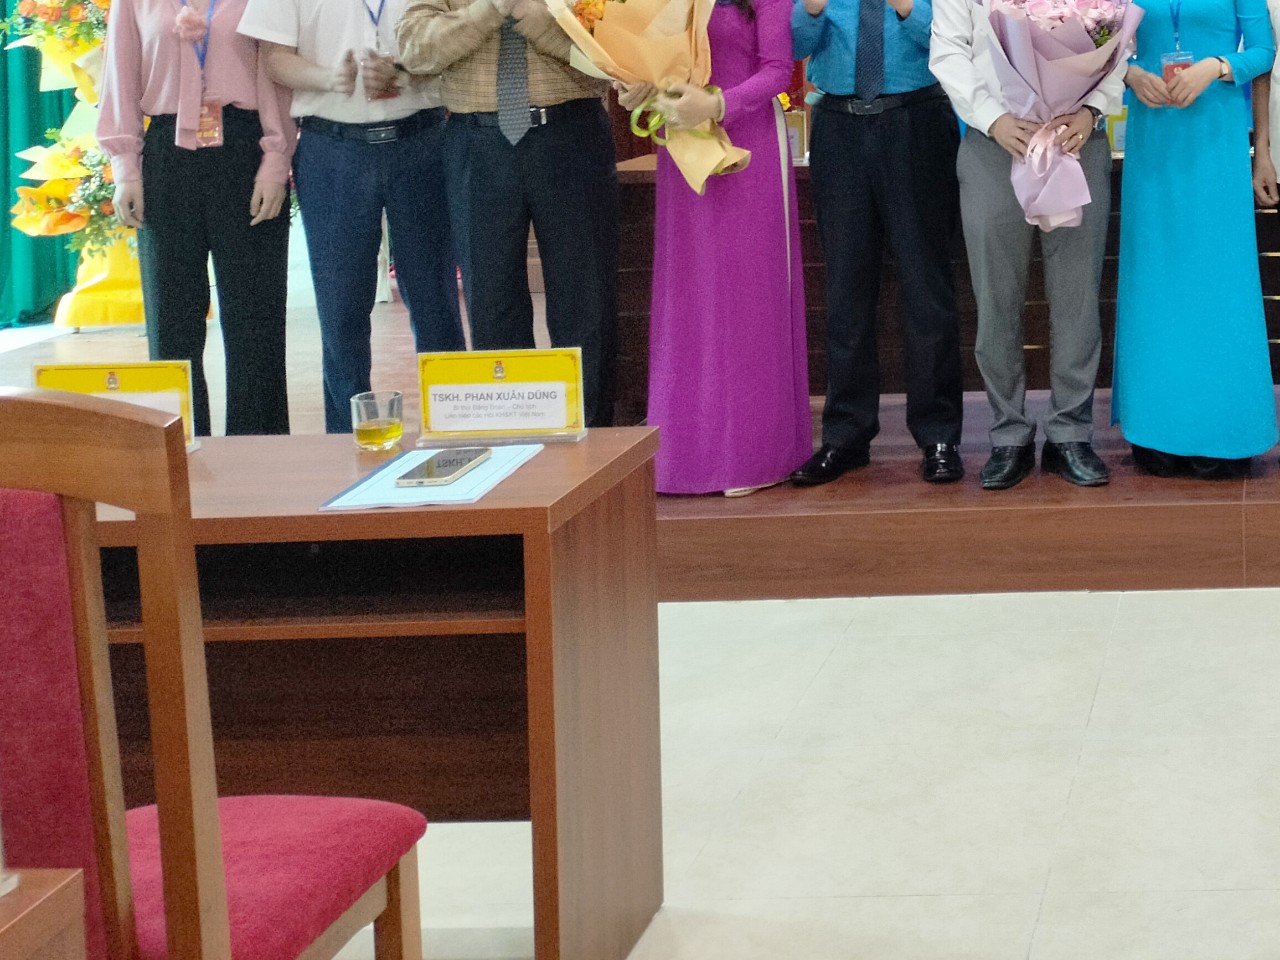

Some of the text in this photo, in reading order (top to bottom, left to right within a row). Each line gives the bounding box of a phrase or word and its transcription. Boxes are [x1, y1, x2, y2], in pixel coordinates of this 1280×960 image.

[432, 389, 558, 403] TSKH. PHAN XUÂN DŨNG
